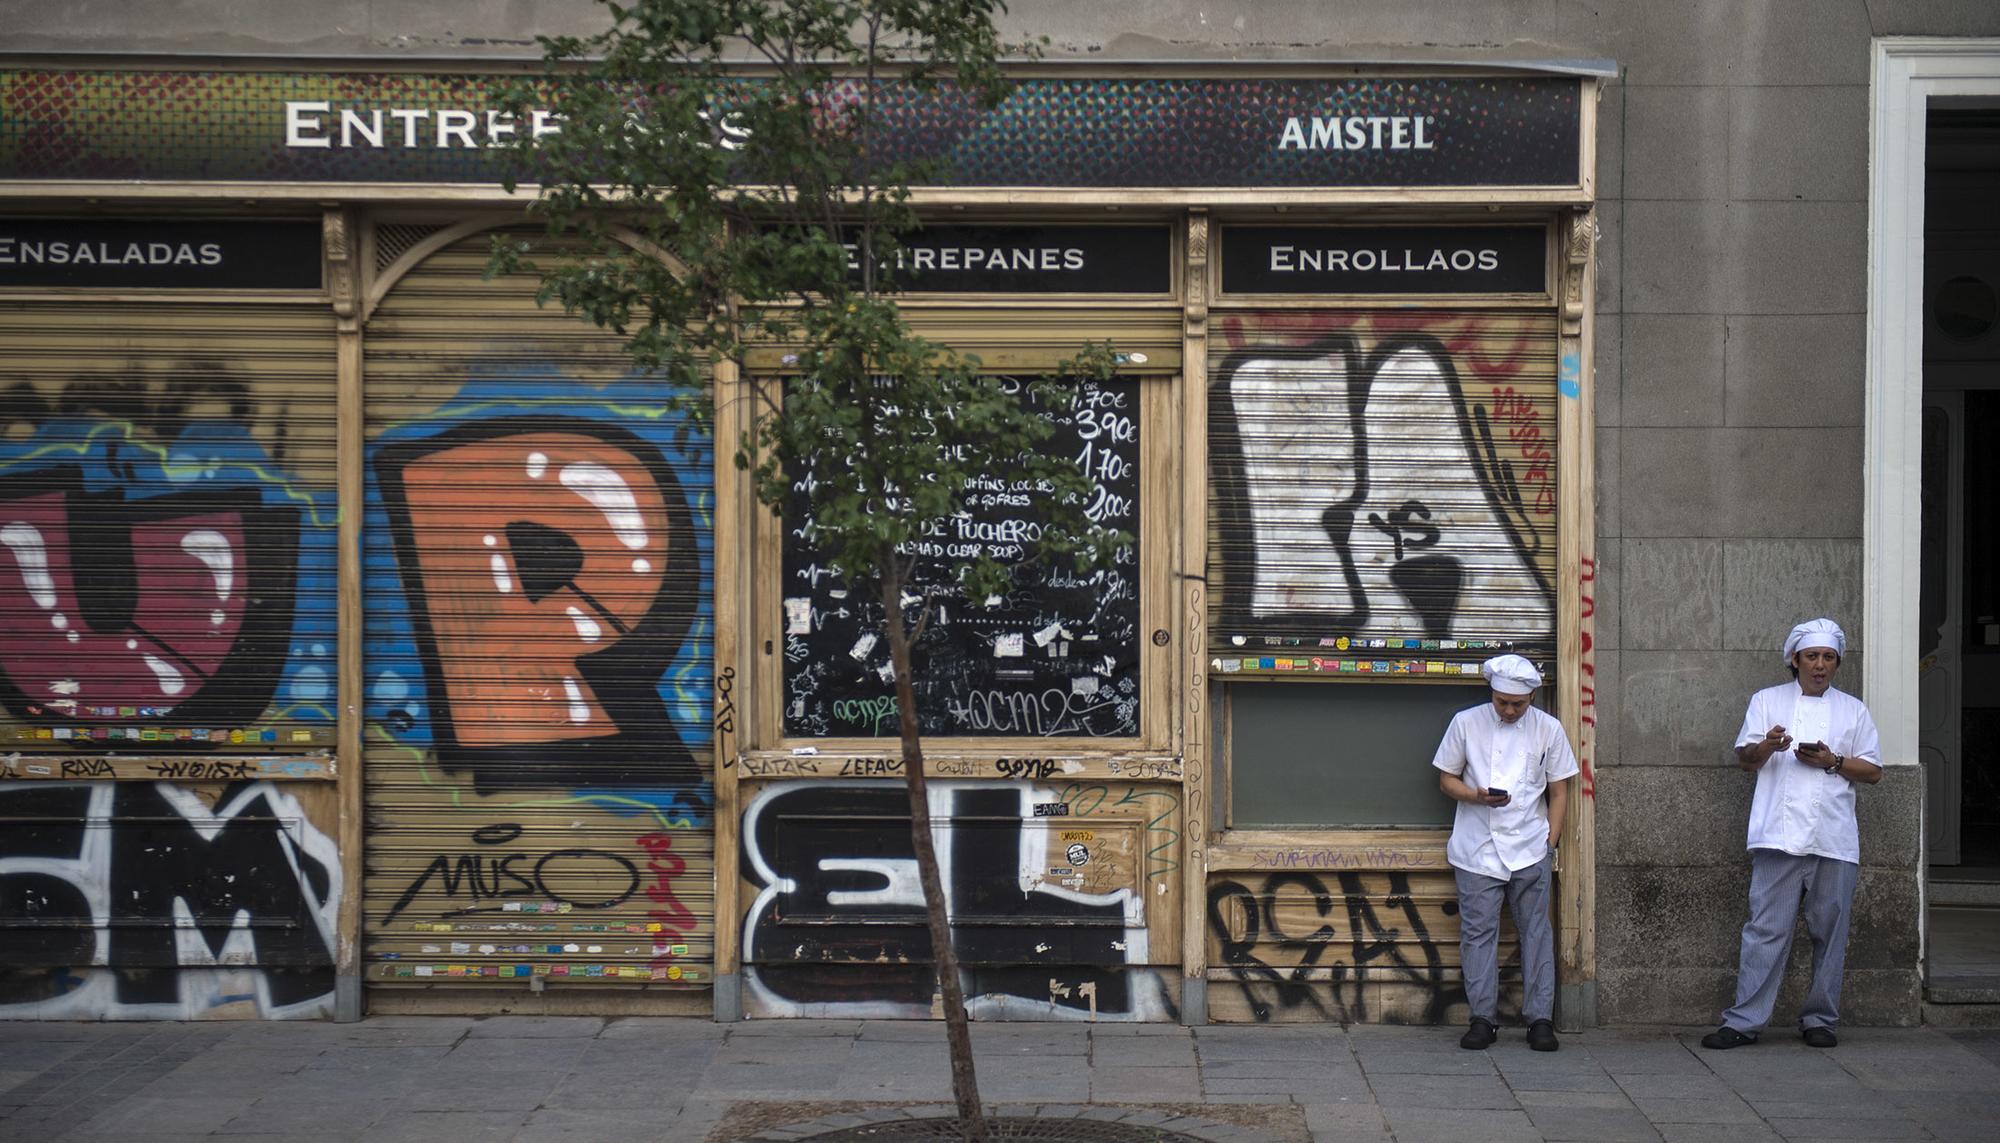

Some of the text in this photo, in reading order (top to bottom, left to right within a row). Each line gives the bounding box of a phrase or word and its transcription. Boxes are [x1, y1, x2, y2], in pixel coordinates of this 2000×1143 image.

[1278, 115, 1434, 150] AMSTEL
[842, 244, 1084, 270] ETREPANES
[1270, 245, 1499, 272] ENROLLAOS
